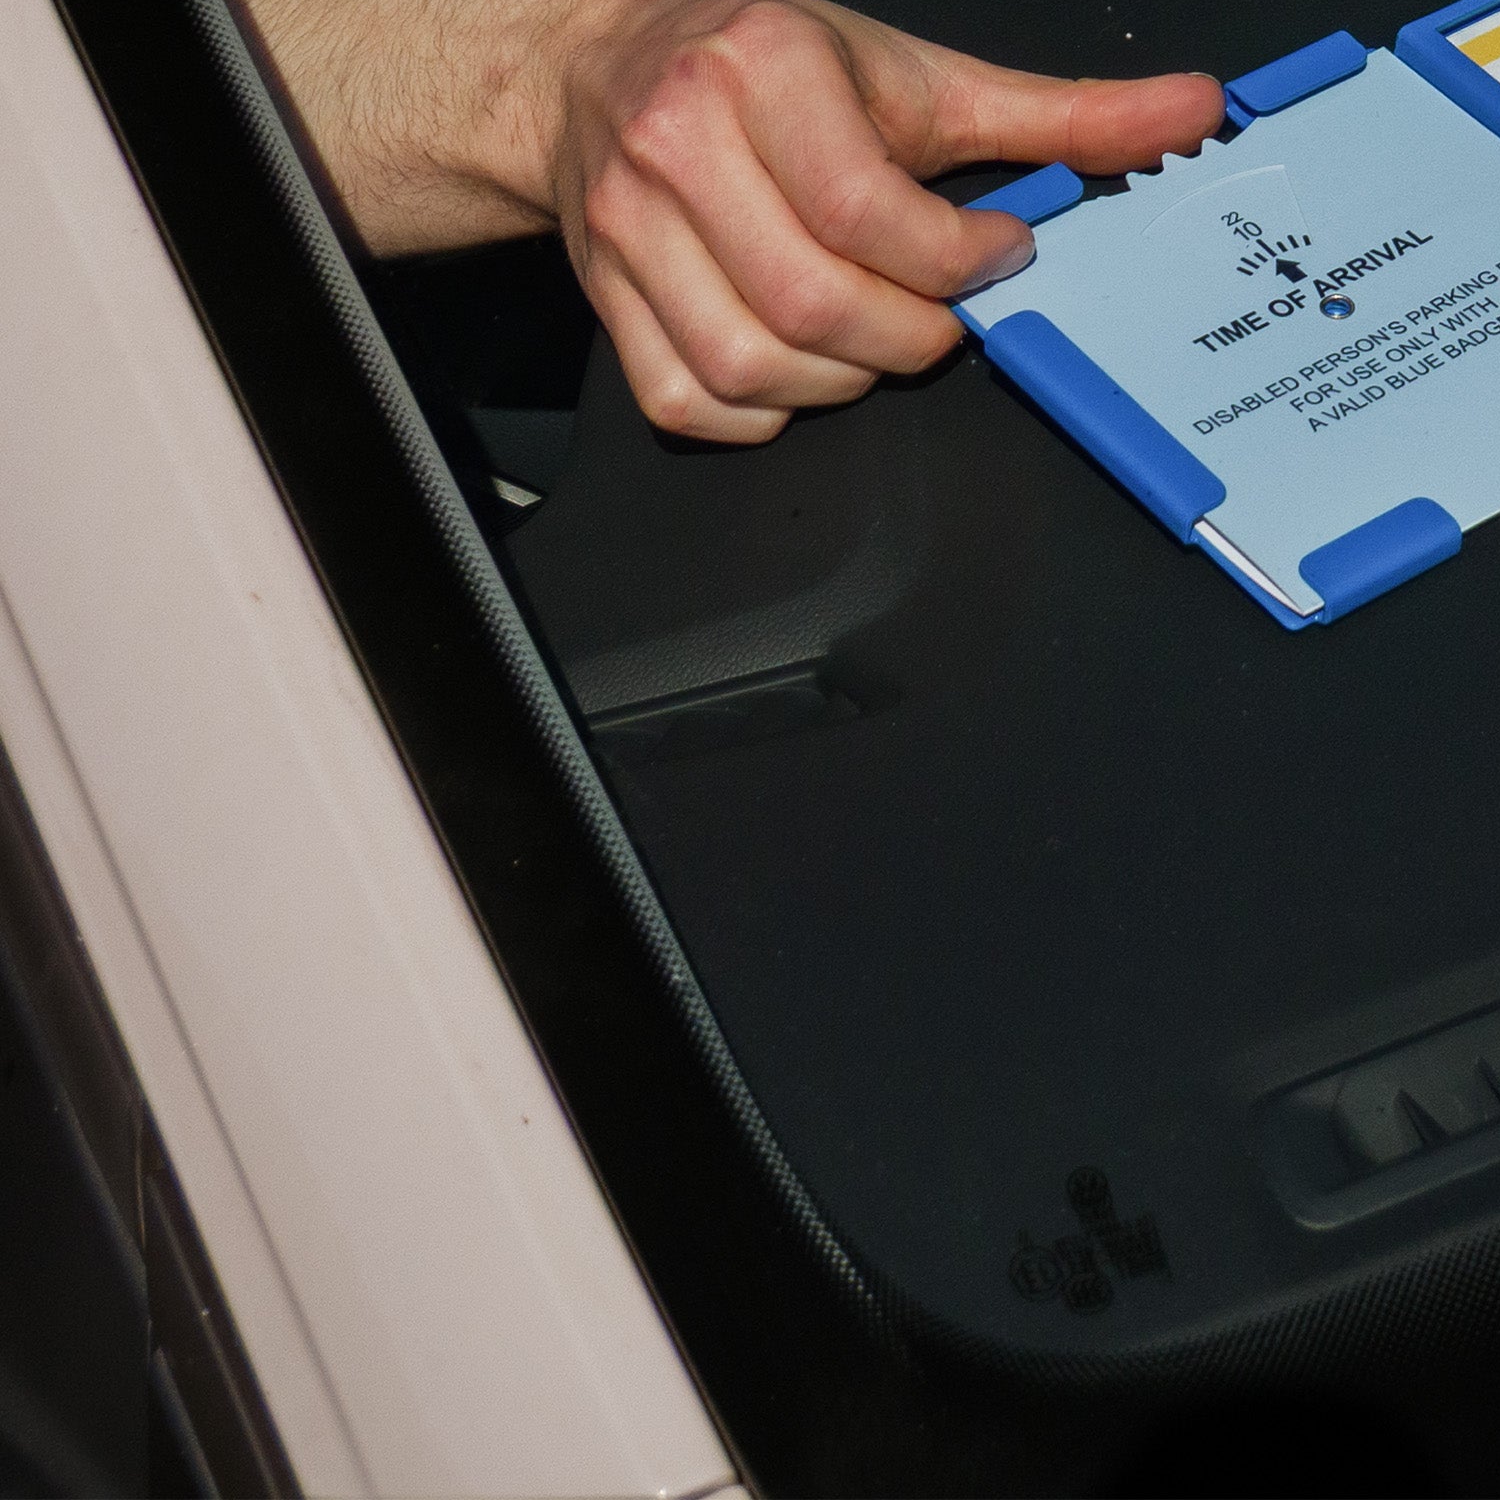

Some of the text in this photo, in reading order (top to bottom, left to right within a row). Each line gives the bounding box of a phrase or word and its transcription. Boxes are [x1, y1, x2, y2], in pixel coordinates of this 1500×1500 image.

[1220, 211, 1244, 227] 22
[1233, 221, 1262, 241] 10
[1193, 229, 1434, 352] TIME OF ARRIVAL
[1193, 376, 1299, 435] DISABLED
[1299, 321, 1407, 381] PERSON'S
[1405, 271, 1498, 325] PARKING
[1289, 297, 1499, 413] FOR USE ONLY WITH
[1308, 417, 1328, 432] A
[1321, 385, 1386, 421] VALID
[1384, 353, 1445, 390] BLUE
